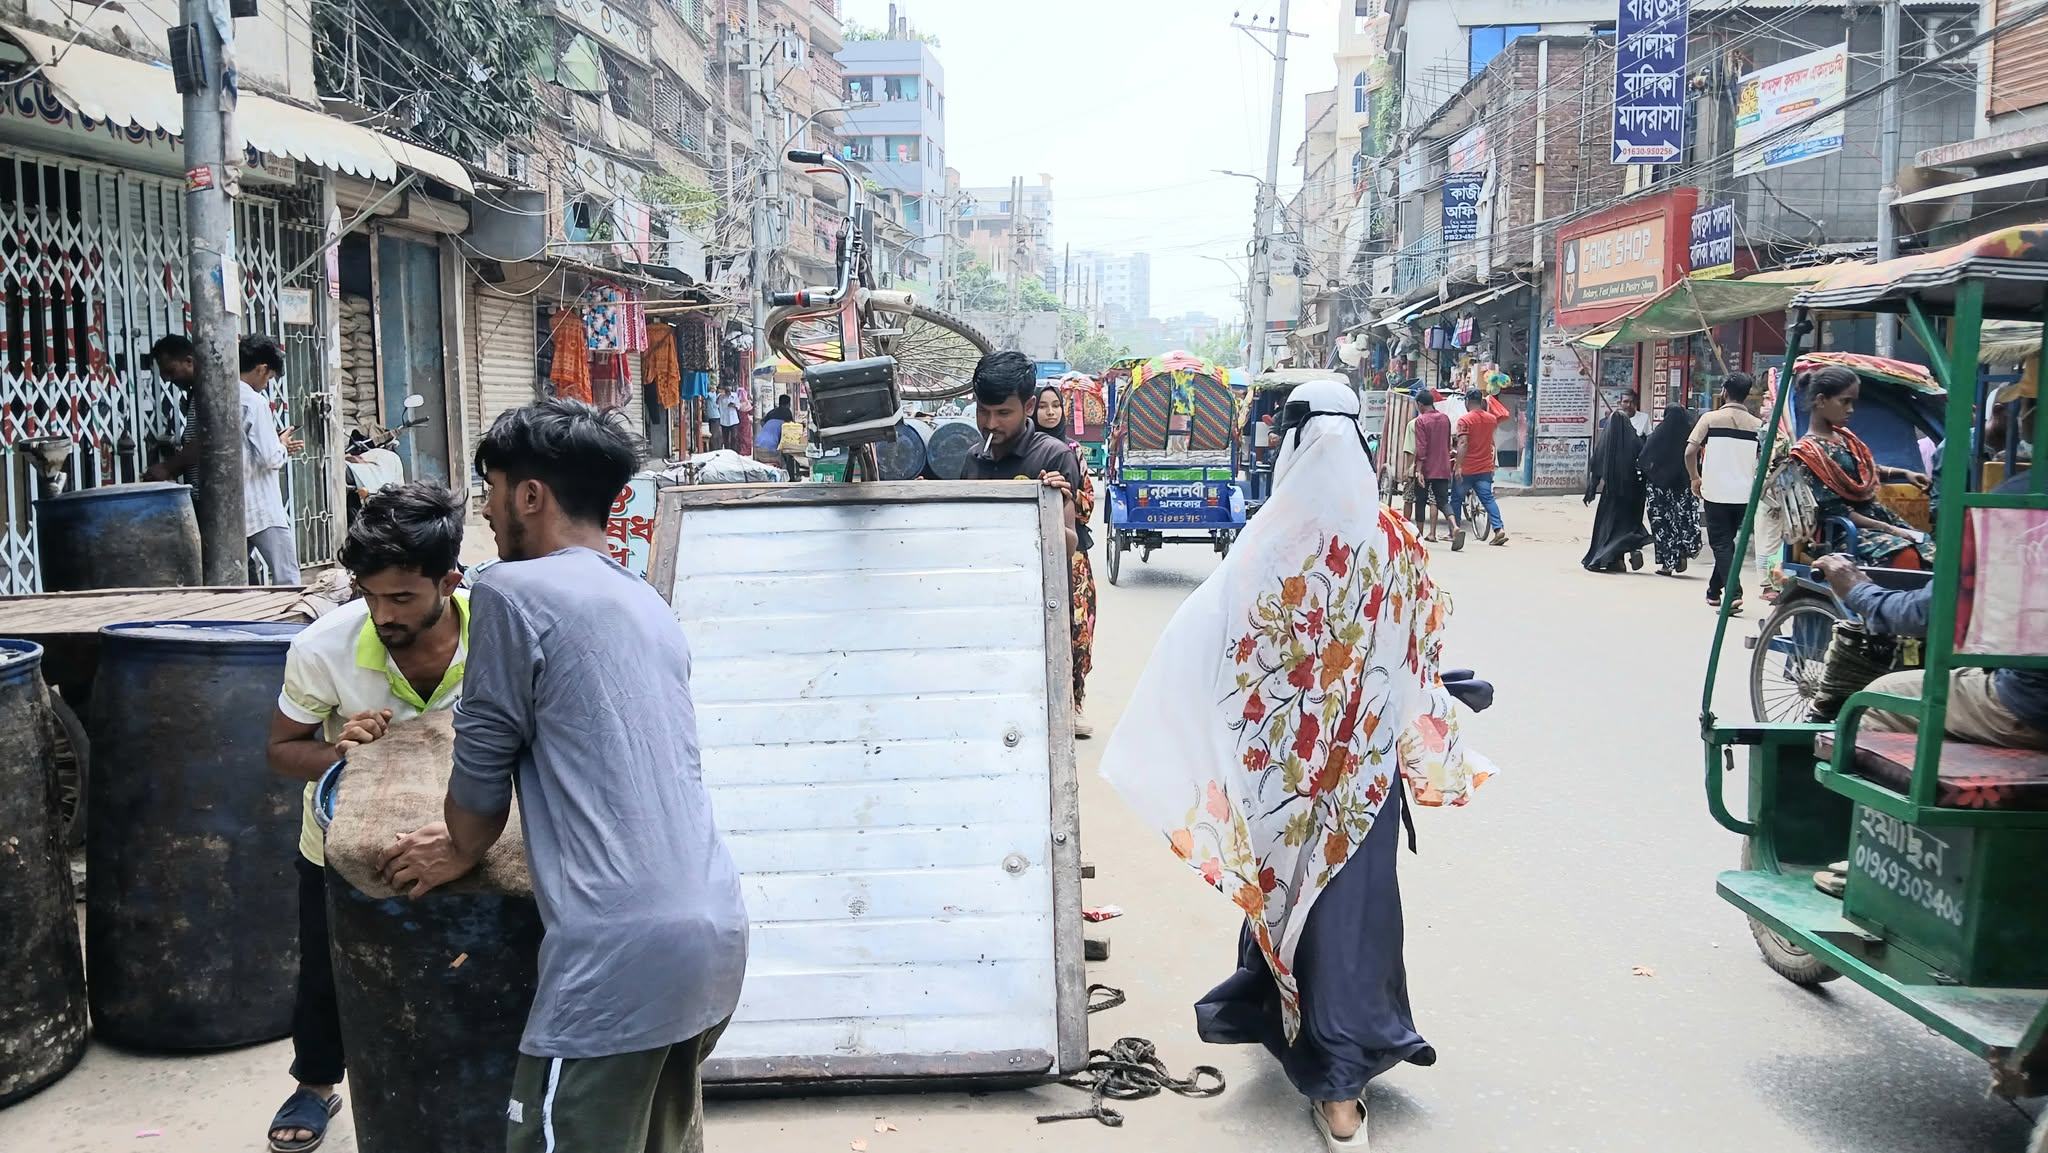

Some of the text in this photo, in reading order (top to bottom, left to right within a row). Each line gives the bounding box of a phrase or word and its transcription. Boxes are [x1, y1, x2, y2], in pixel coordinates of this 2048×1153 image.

[1627, 31, 1677, 60] সালাম
[1622, 63, 1680, 99] বালিকা
[1622, 147, 1673, 155] 01630-950256
[1583, 227, 1652, 273] CAKE SHOP
[1855, 845, 1963, 926] 01969303406
